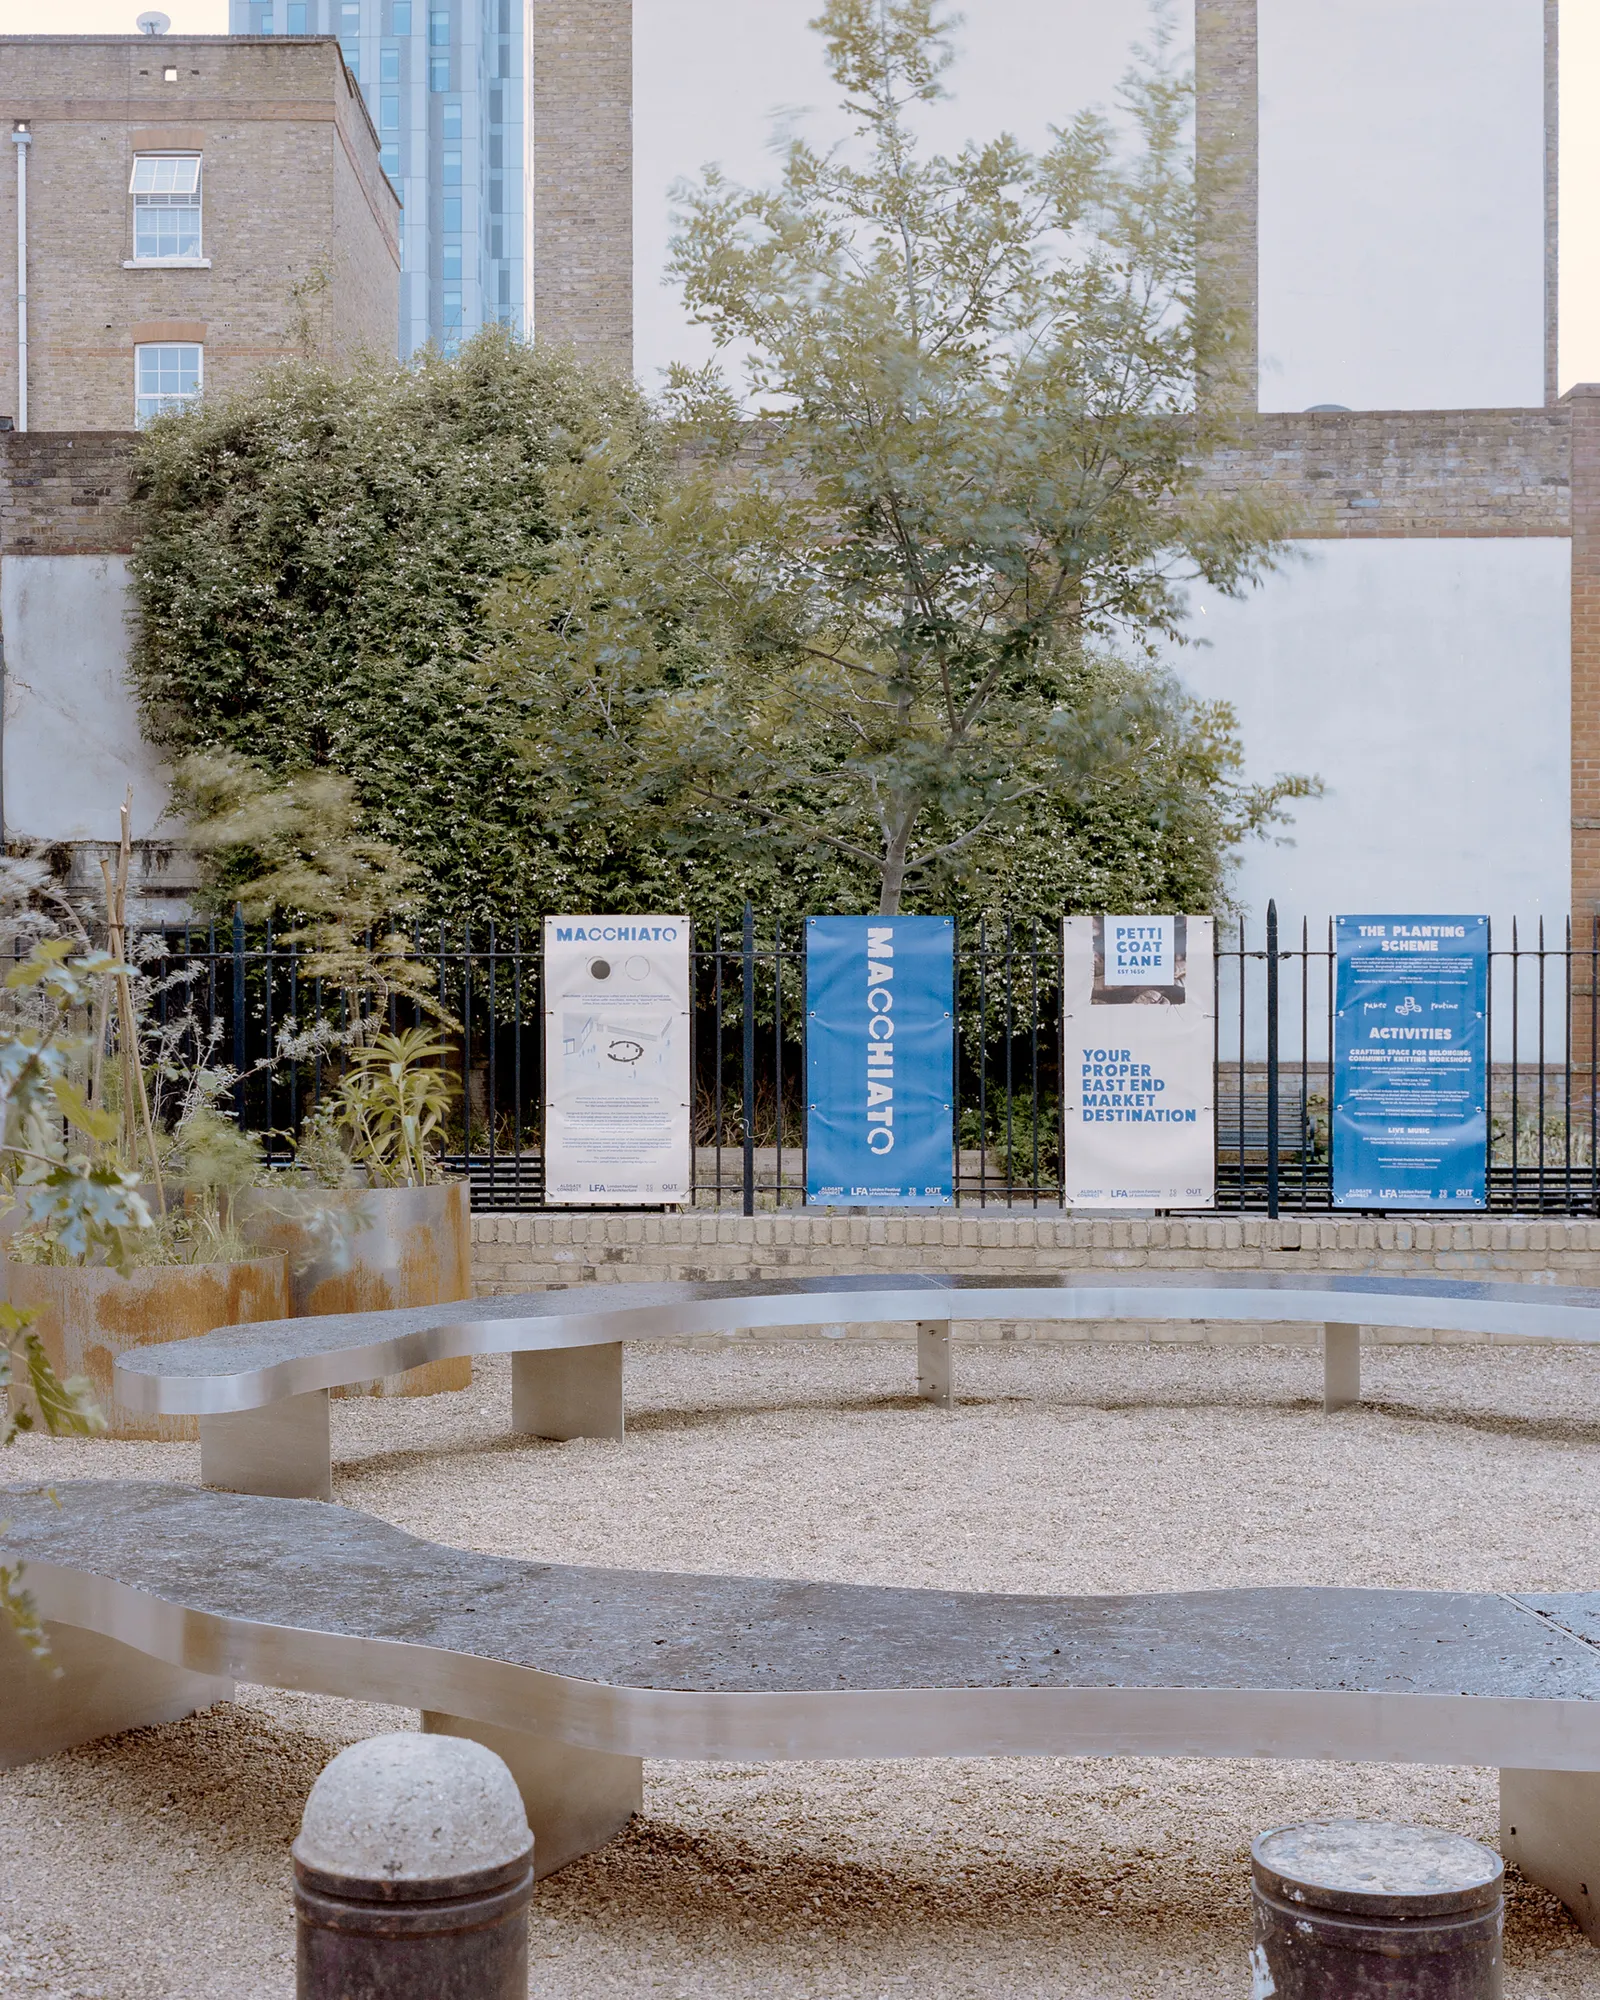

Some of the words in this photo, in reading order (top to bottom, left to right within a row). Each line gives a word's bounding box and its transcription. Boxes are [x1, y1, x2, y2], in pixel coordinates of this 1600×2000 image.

[556, 927, 677, 942] MACCHIATO
[1116, 928, 1162, 939] PETTI
[1359, 926, 1385, 936] THE
[1393, 926, 1465, 937] PLANTING
[1116, 941, 1162, 953] COAT
[1381, 941, 1438, 951] SCHEME
[1118, 956, 1162, 966] LANE
[1370, 1027, 1452, 1040] ACTIVITIES
[867, 927, 895, 1155] MACCHIATO
[1082, 1050, 1131, 1062] YOUR
[1082, 1064, 1151, 1076] PROPER
[1082, 1079, 1125, 1092] EAST
[1130, 1079, 1165, 1092] END
[1082, 1094, 1156, 1106] MARKET
[1083, 1109, 1196, 1122] DESTINATION
[589, 1184, 606, 1192] LFA
[851, 1188, 868, 1196] LFA
[1380, 1189, 1397, 1198] LFA
